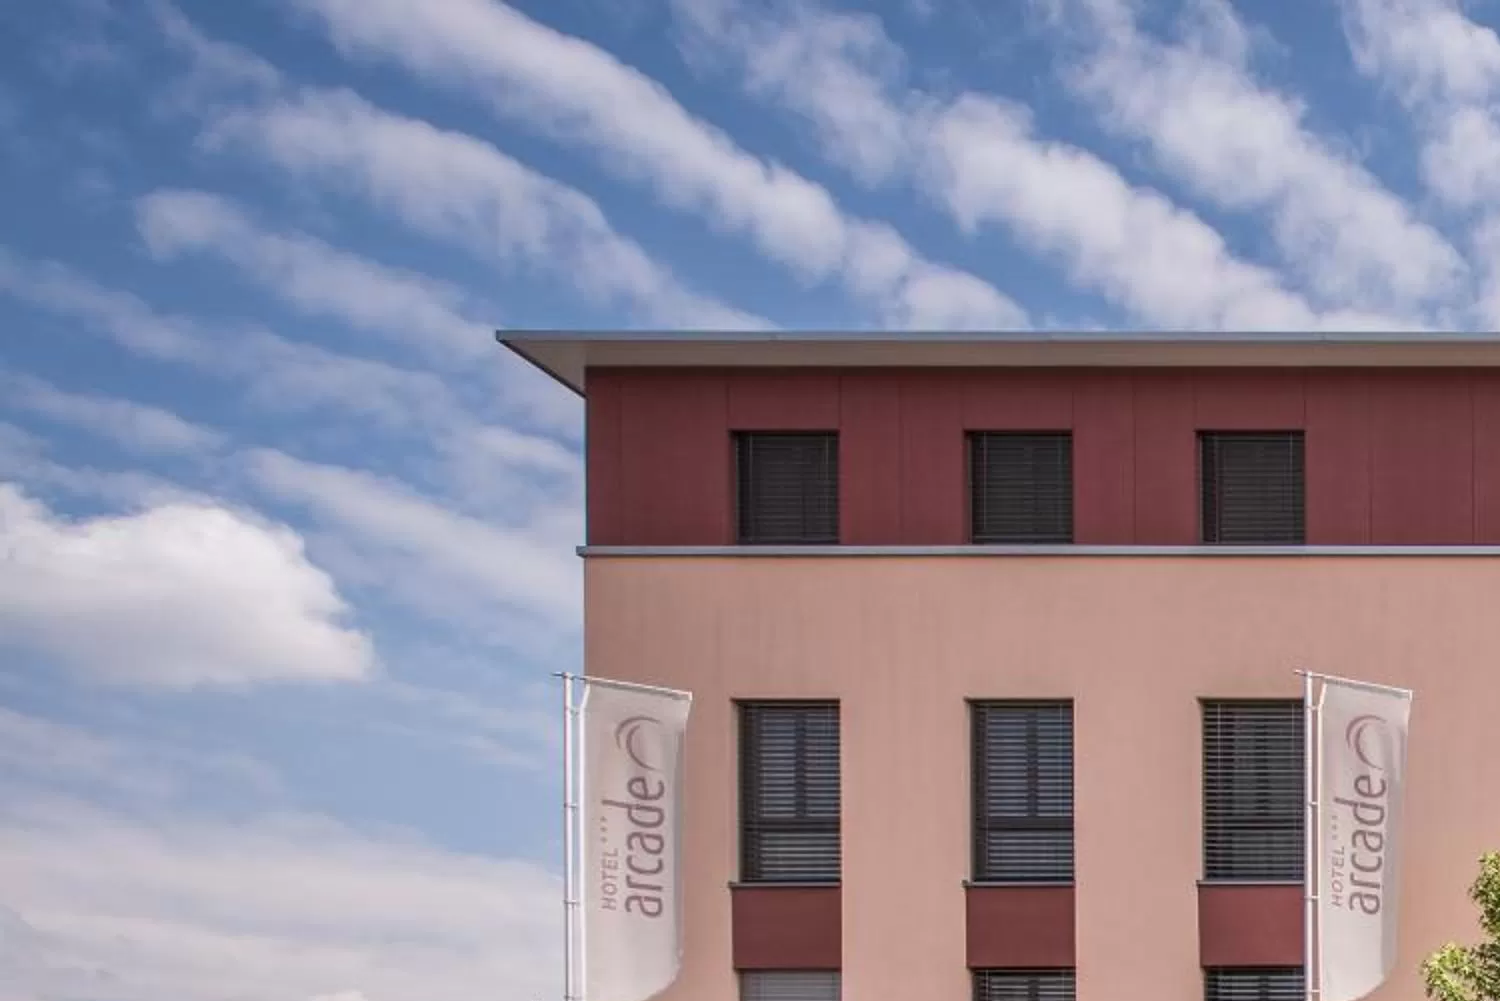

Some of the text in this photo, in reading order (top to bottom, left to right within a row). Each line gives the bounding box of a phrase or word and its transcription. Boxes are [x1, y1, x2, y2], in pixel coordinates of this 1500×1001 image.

[601, 776, 665, 918] arcade
[601, 848, 618, 911] HOTEL
[1331, 846, 1345, 907] HOTEL
[1333, 774, 1386, 915] arcade
